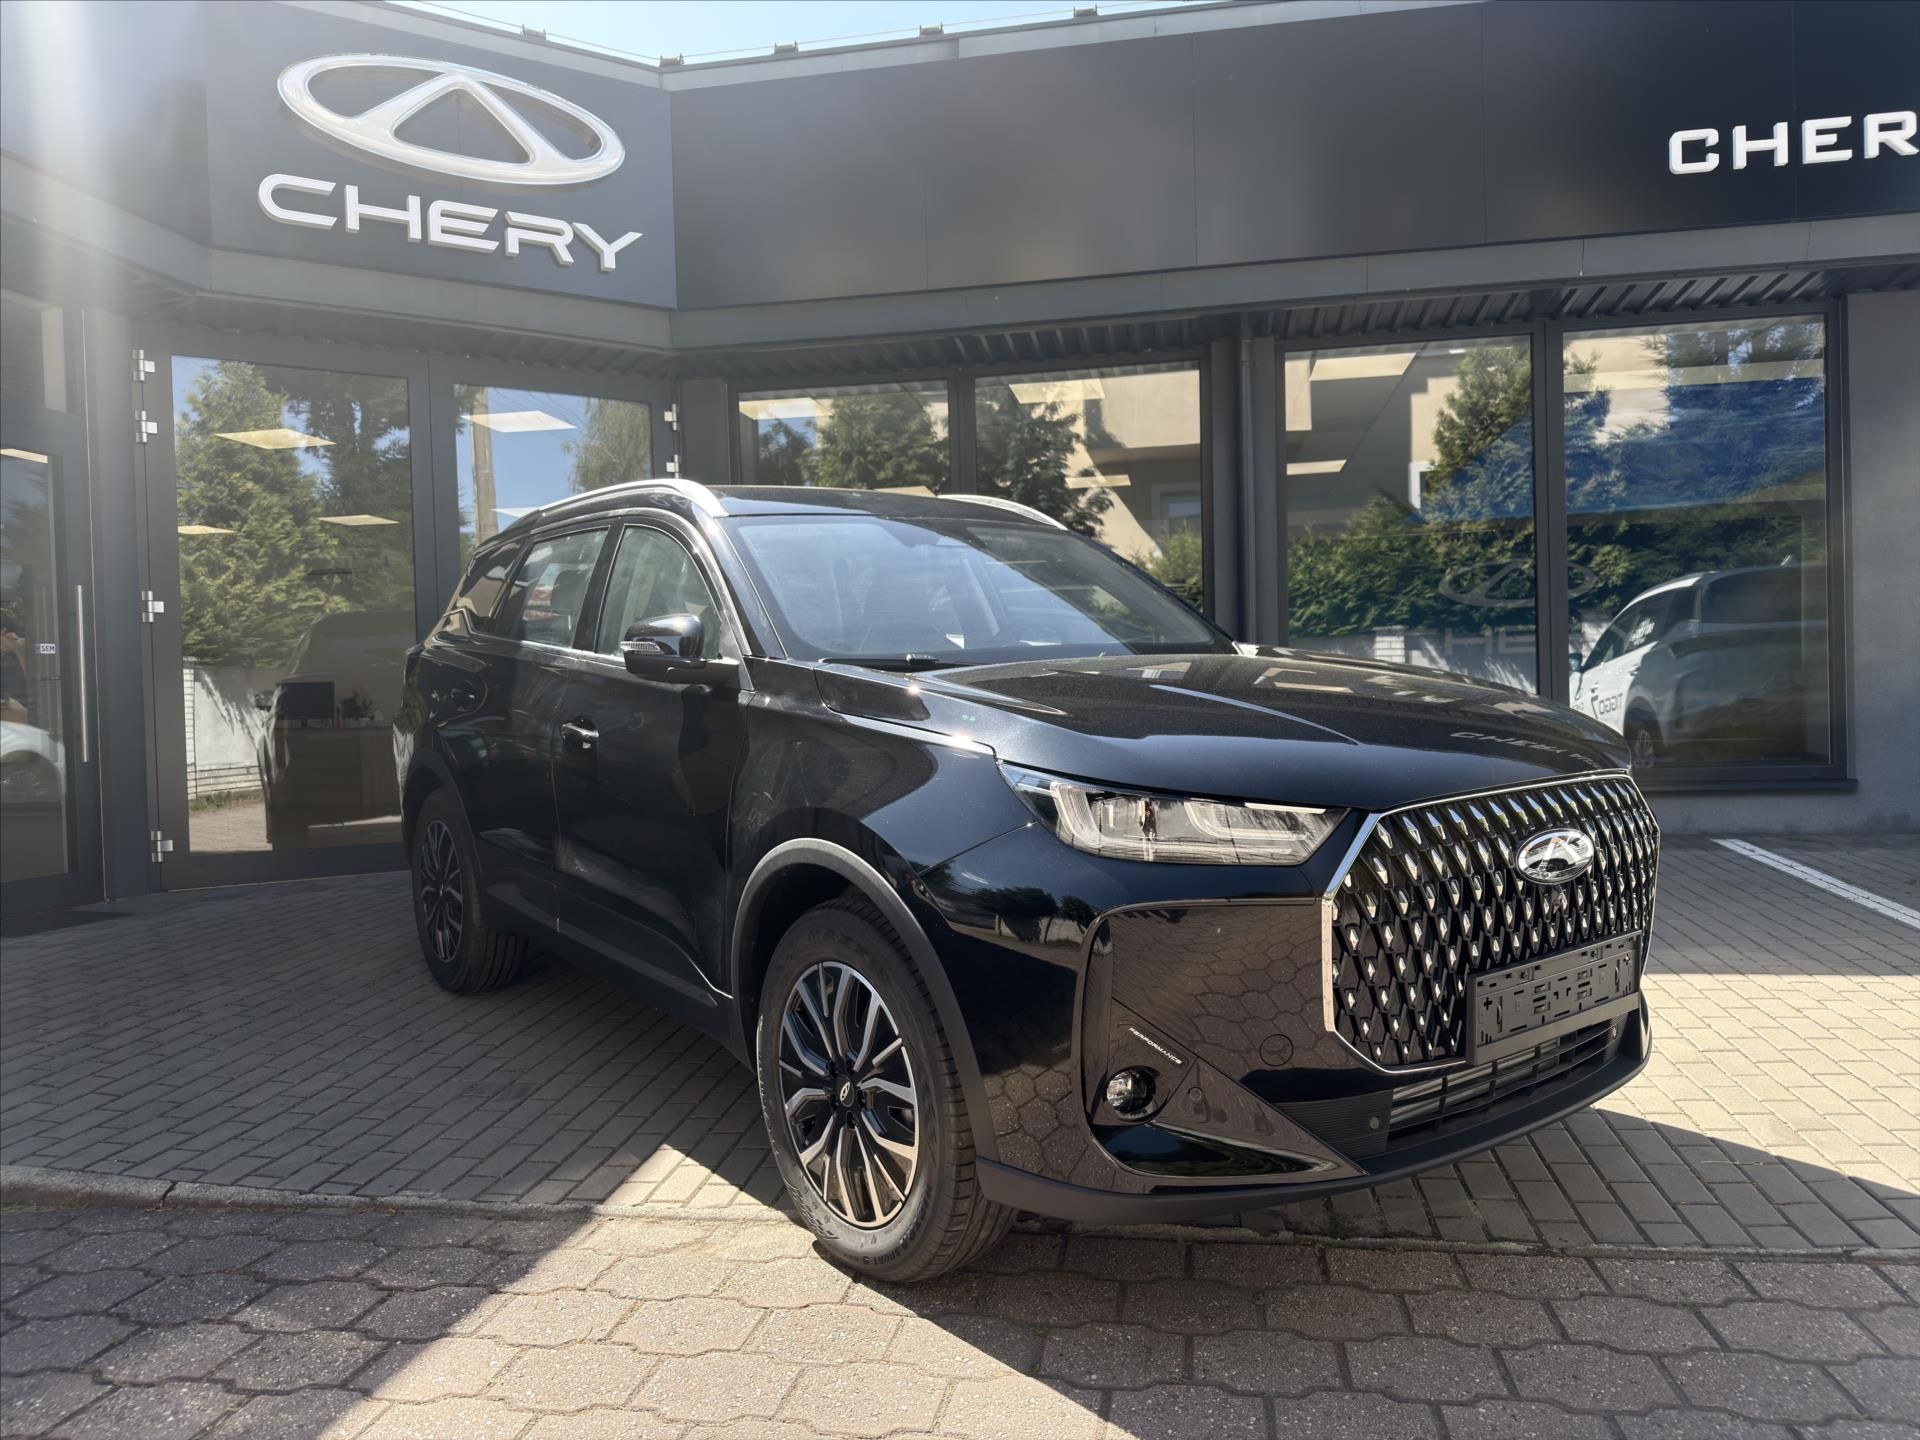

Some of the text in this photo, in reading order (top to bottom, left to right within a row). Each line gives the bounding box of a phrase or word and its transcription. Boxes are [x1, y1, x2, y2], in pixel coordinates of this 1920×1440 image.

[1669, 110, 1920, 175] CHER
[258, 173, 643, 271] CHERY
[1128, 1027, 1182, 1064] PERFORMANCE
[873, 1246, 901, 1265] SPORT
